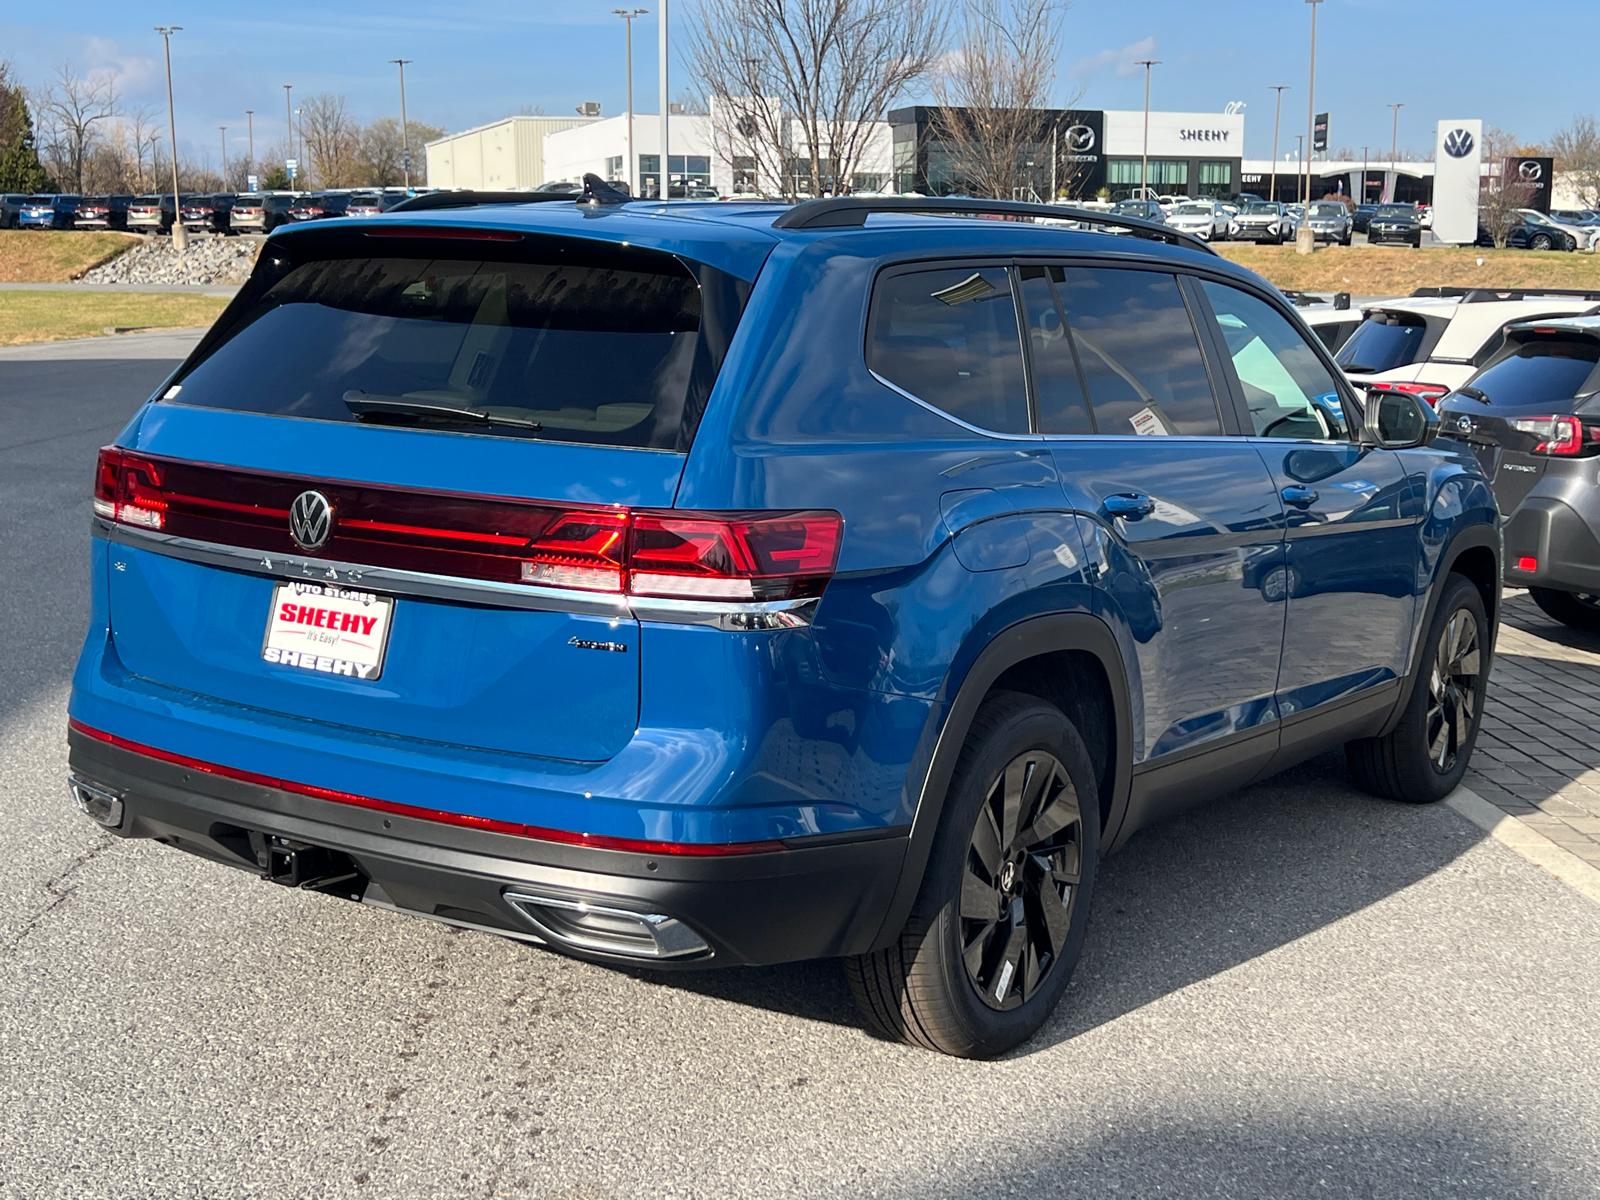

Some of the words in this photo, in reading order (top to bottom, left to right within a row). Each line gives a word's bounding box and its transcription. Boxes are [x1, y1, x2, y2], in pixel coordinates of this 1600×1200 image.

[1179, 129, 1229, 141] SHEEHY
[260, 557, 363, 582] ATLAS
[287, 582, 322, 595] AUTO
[324, 586, 377, 603] STORES
[280, 602, 378, 634] SHEEHY
[307, 630, 318, 641] It's
[319, 632, 340, 646] Easy!
[264, 647, 374, 679] SHEEHY
